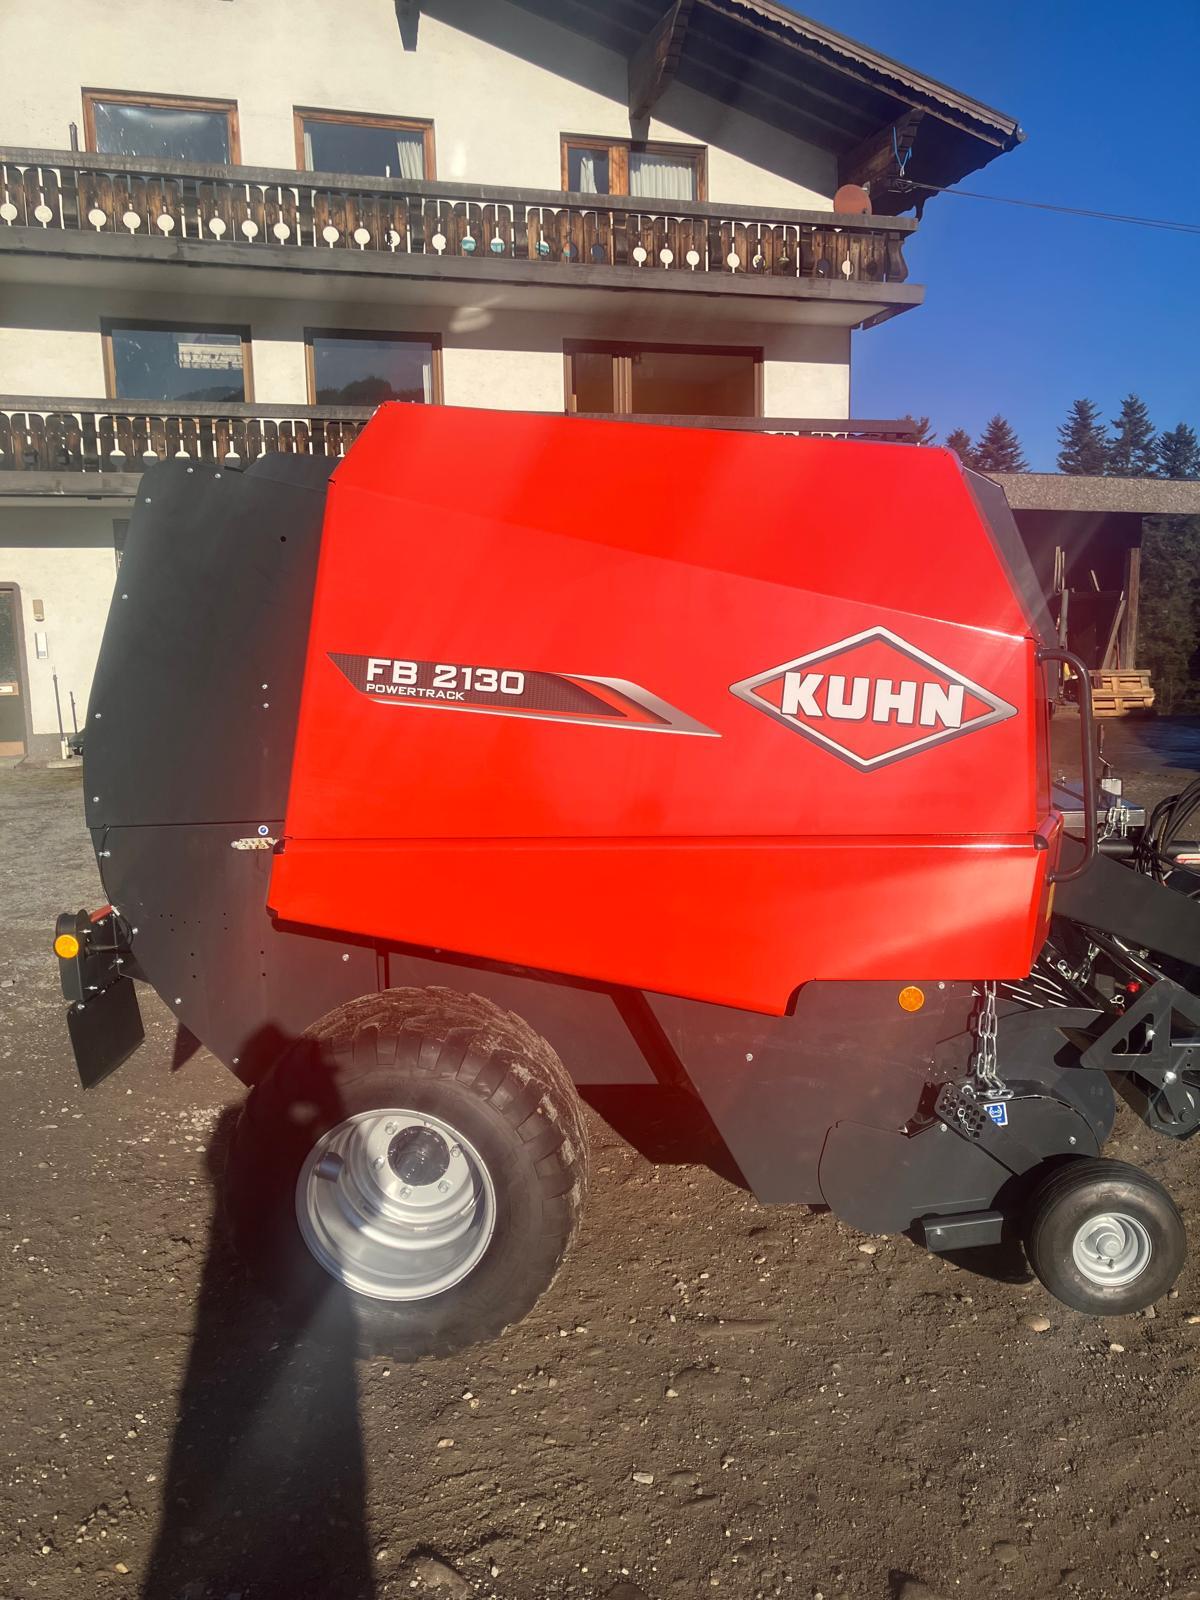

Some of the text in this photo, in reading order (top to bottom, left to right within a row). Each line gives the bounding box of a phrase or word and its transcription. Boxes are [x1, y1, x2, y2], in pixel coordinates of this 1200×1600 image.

[366, 658, 525, 695] FB 2130
[366, 683, 465, 701] POWERTRACK
[781, 671, 965, 729] KUHN
